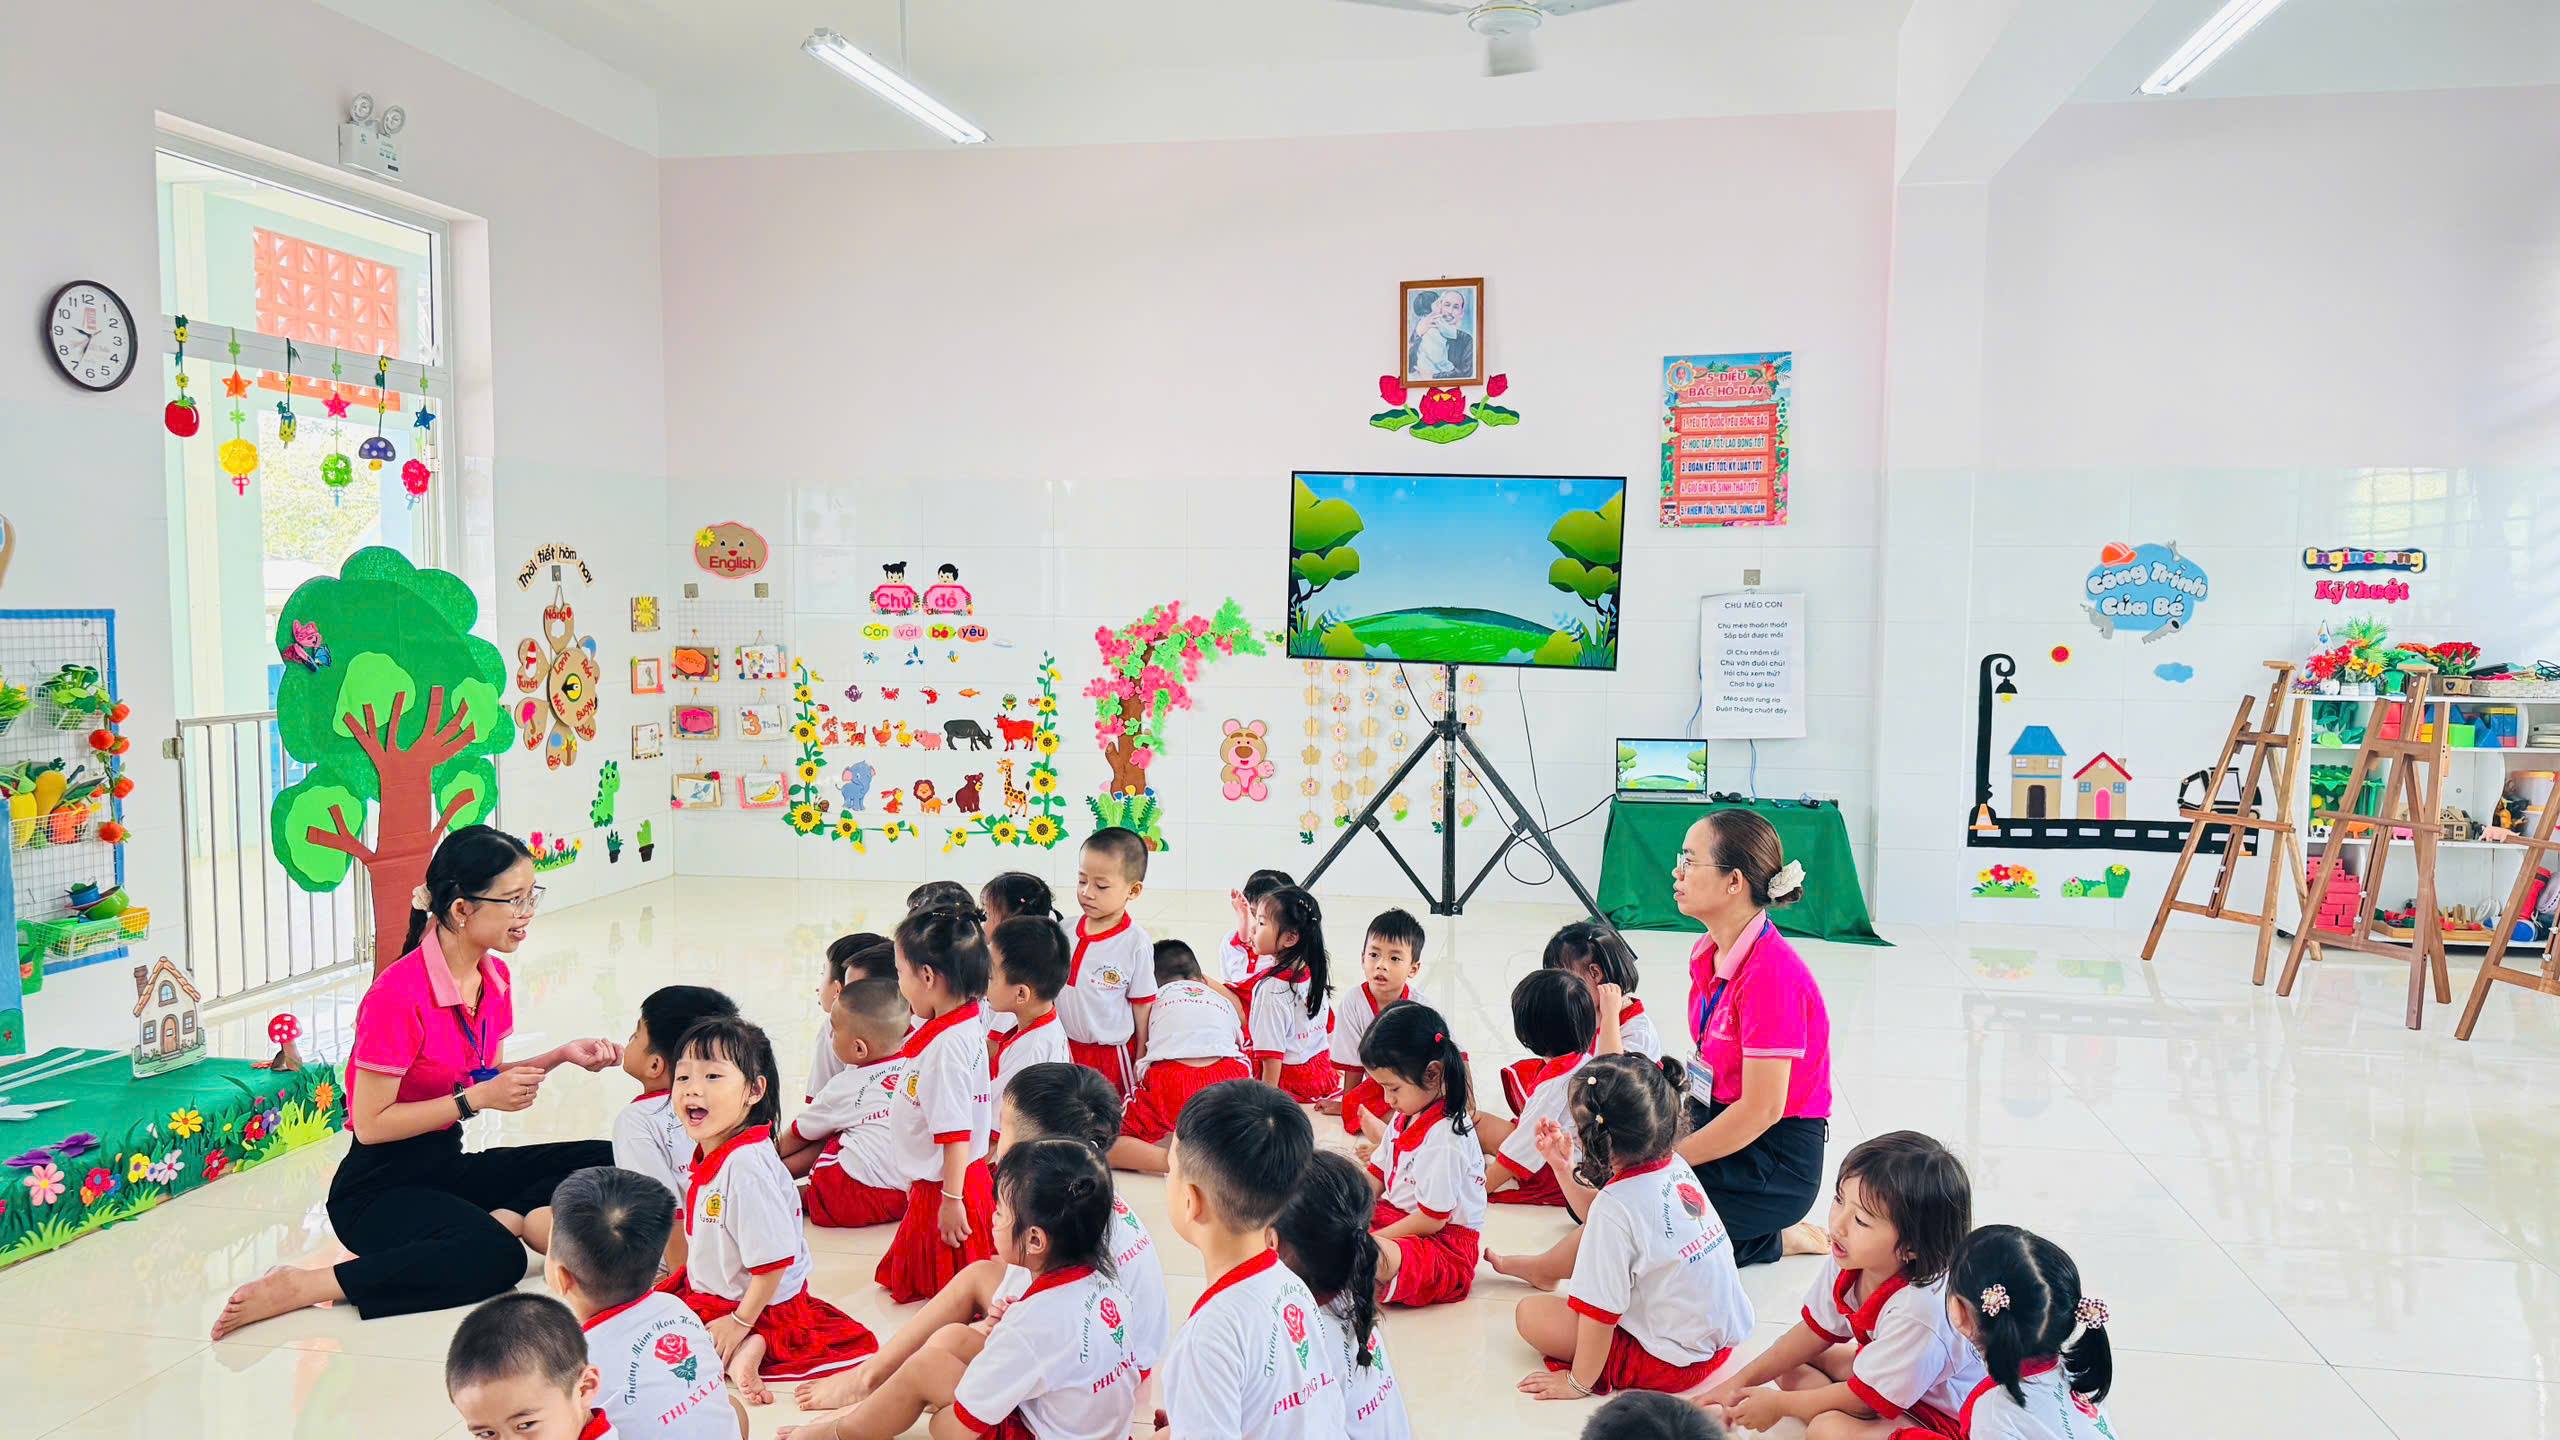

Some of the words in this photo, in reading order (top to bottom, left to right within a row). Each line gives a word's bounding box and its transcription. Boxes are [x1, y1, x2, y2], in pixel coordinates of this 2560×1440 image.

[68, 297, 77, 307] 11
[82, 294, 95, 305] 12
[59, 309, 71, 320] 10
[109, 318, 119, 329] 2
[54, 326, 64, 336] 9
[113, 336, 122, 347] 3
[59, 345, 69, 356] 8
[110, 354, 119, 363] 4
[71, 360, 79, 371] 7
[101, 366, 111, 376] 5
[85, 368, 96, 379] 6
[518, 560, 538, 588] Thời
[538, 544, 555, 563] tiết
[559, 547, 577, 560] hôm
[579, 561, 593, 583] nay
[709, 556, 757, 572] English
[2087, 564, 2148, 595] Công
[2150, 561, 2208, 598] Trình
[2346, 578, 2410, 604] thuật
[877, 590, 913, 609] Chủ
[2101, 594, 2149, 616] Của
[2151, 594, 2184, 617] Bé
[863, 625, 889, 637] Con
[932, 626, 949, 639] bé
[961, 626, 985, 638] yêu
[547, 754, 561, 767] Gió
[658, 1402, 688, 1425] THỊ
[688, 1384, 709, 1407] XÃ
